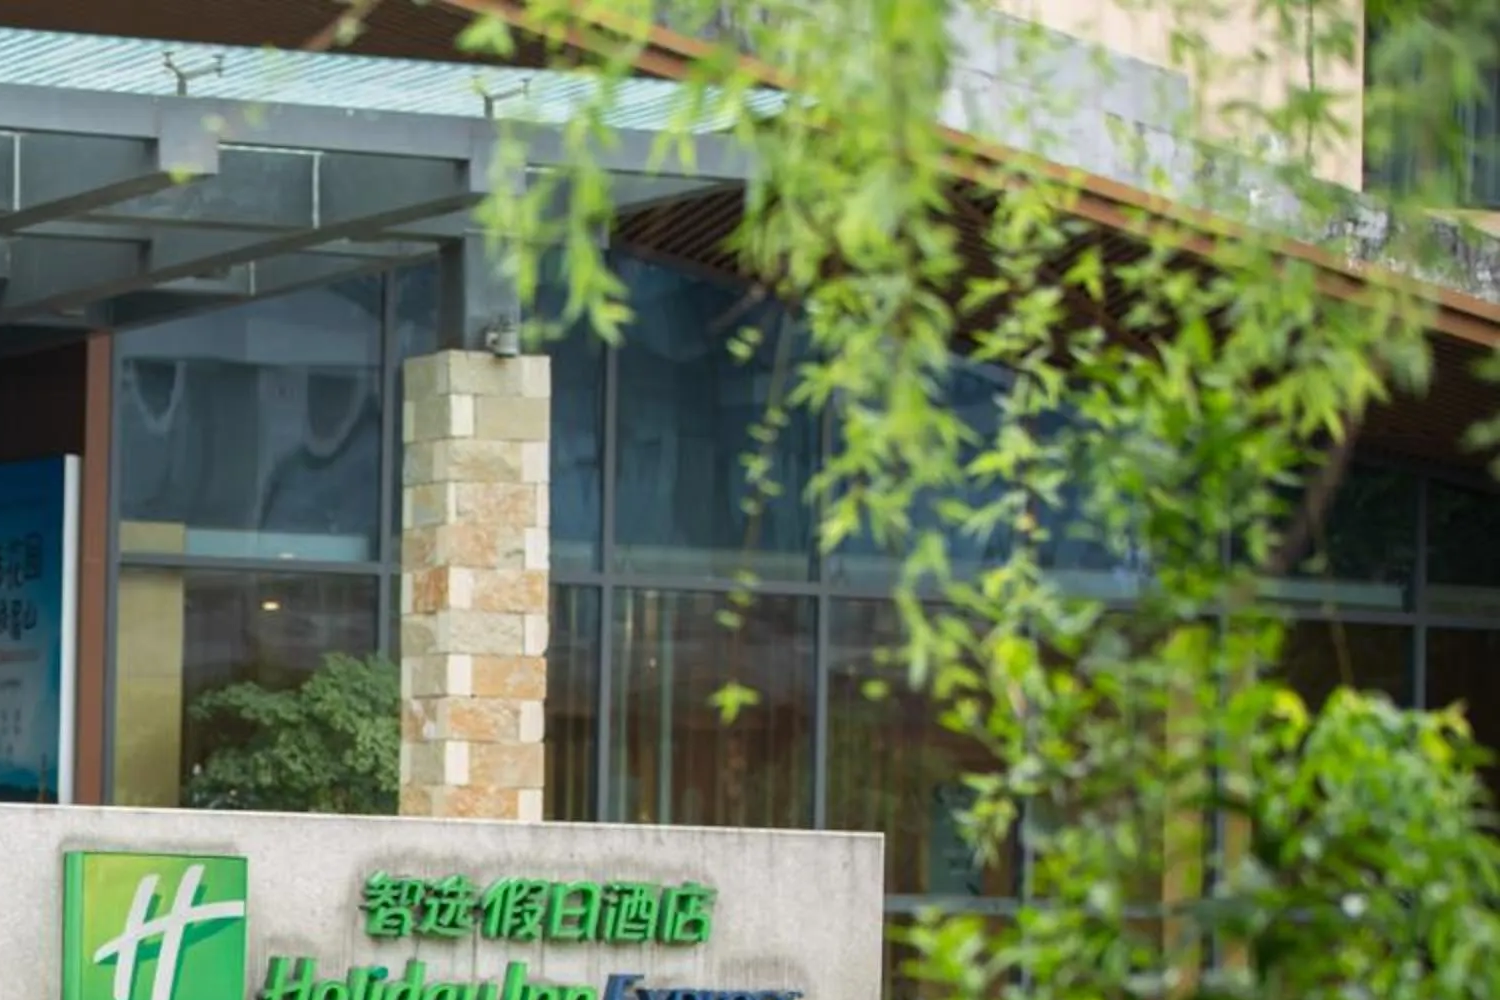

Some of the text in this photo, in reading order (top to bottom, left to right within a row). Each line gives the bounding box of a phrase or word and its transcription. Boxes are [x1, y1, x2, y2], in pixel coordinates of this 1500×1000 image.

[362, 870, 717, 943] 智选假日酒店
